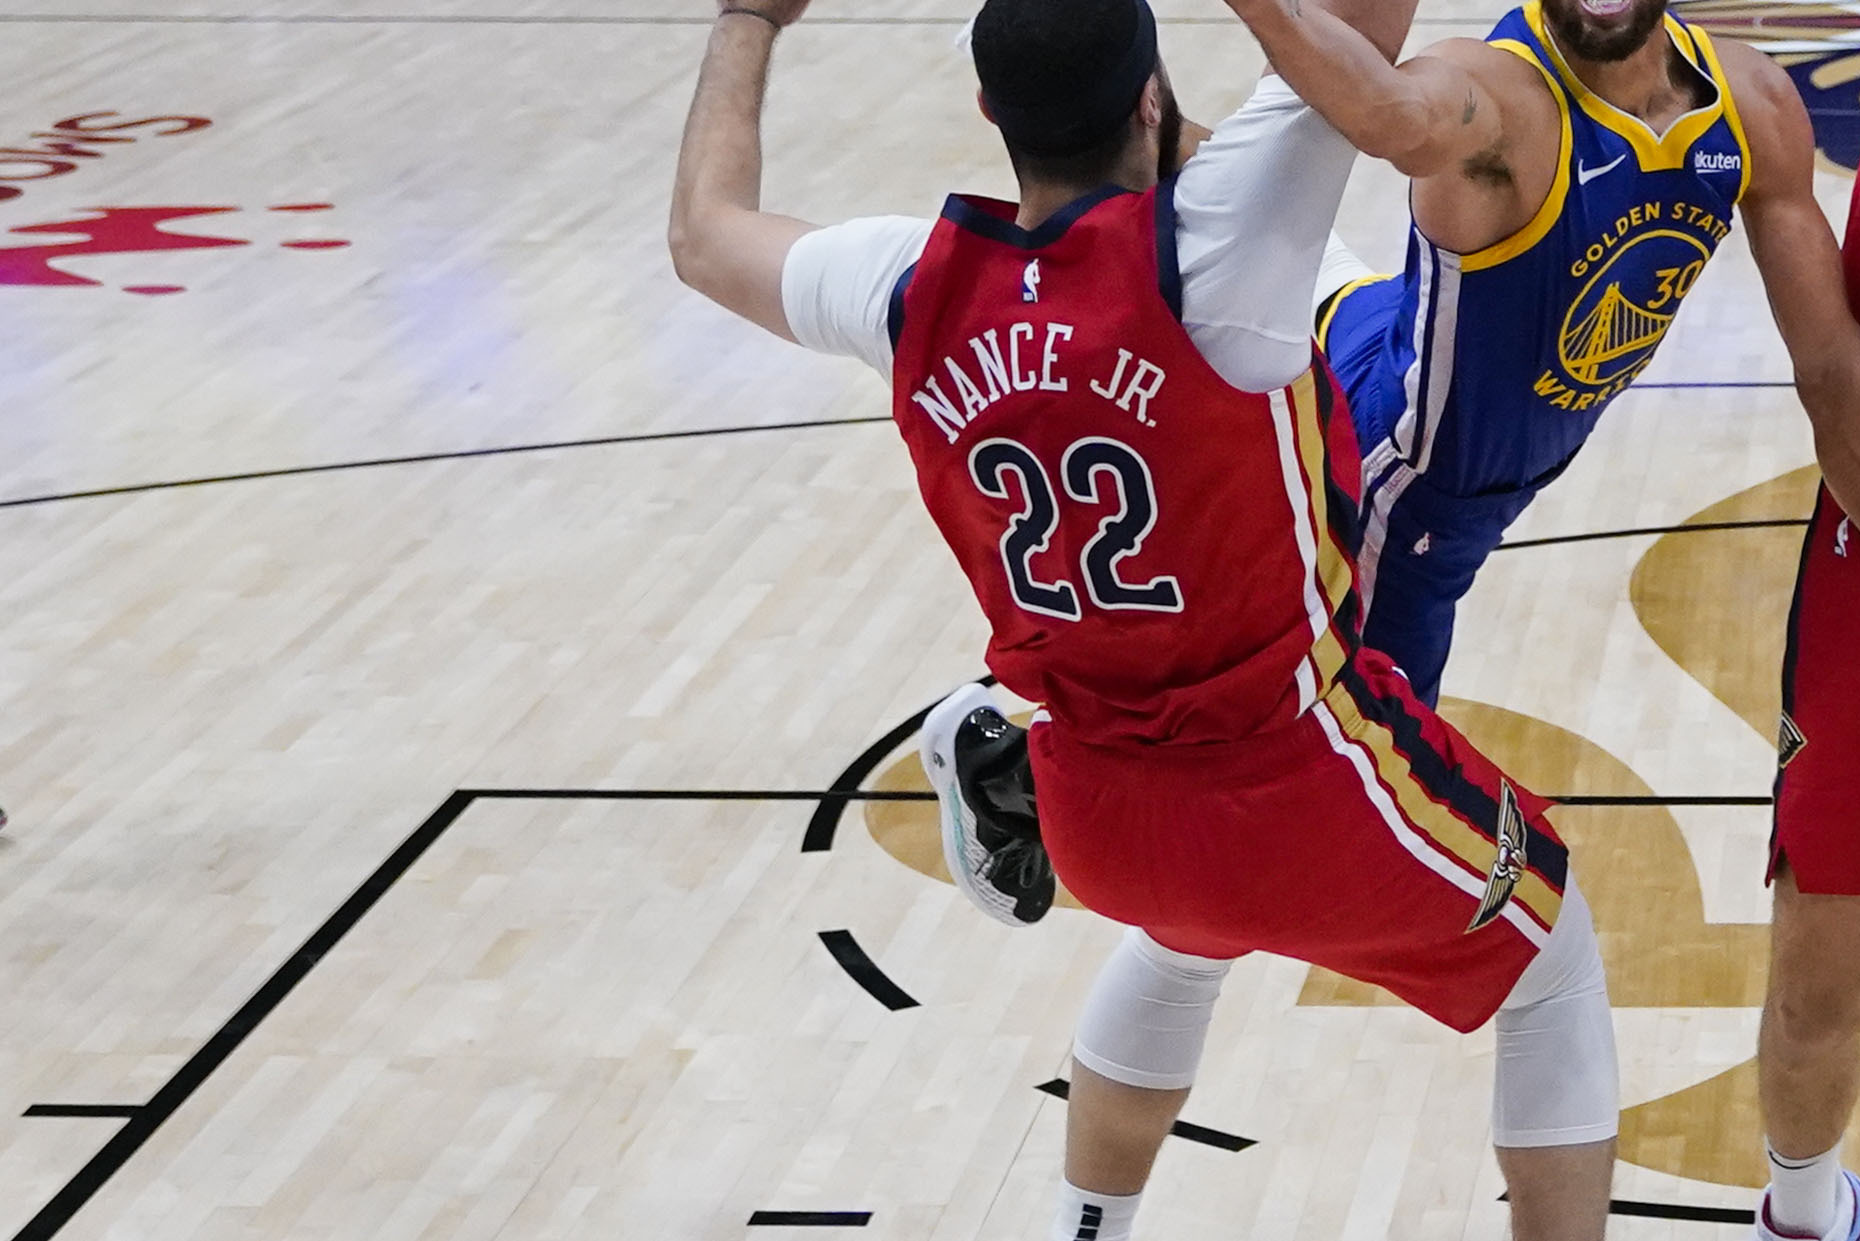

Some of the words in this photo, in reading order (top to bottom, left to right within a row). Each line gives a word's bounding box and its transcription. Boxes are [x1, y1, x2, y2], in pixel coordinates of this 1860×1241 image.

[1570, 201, 1661, 279] GOLDEN
[1647, 260, 1705, 309] 30
[911, 321, 1075, 446] NANCE
[1089, 346, 1167, 429] JR.
[966, 435, 1185, 623] 22
